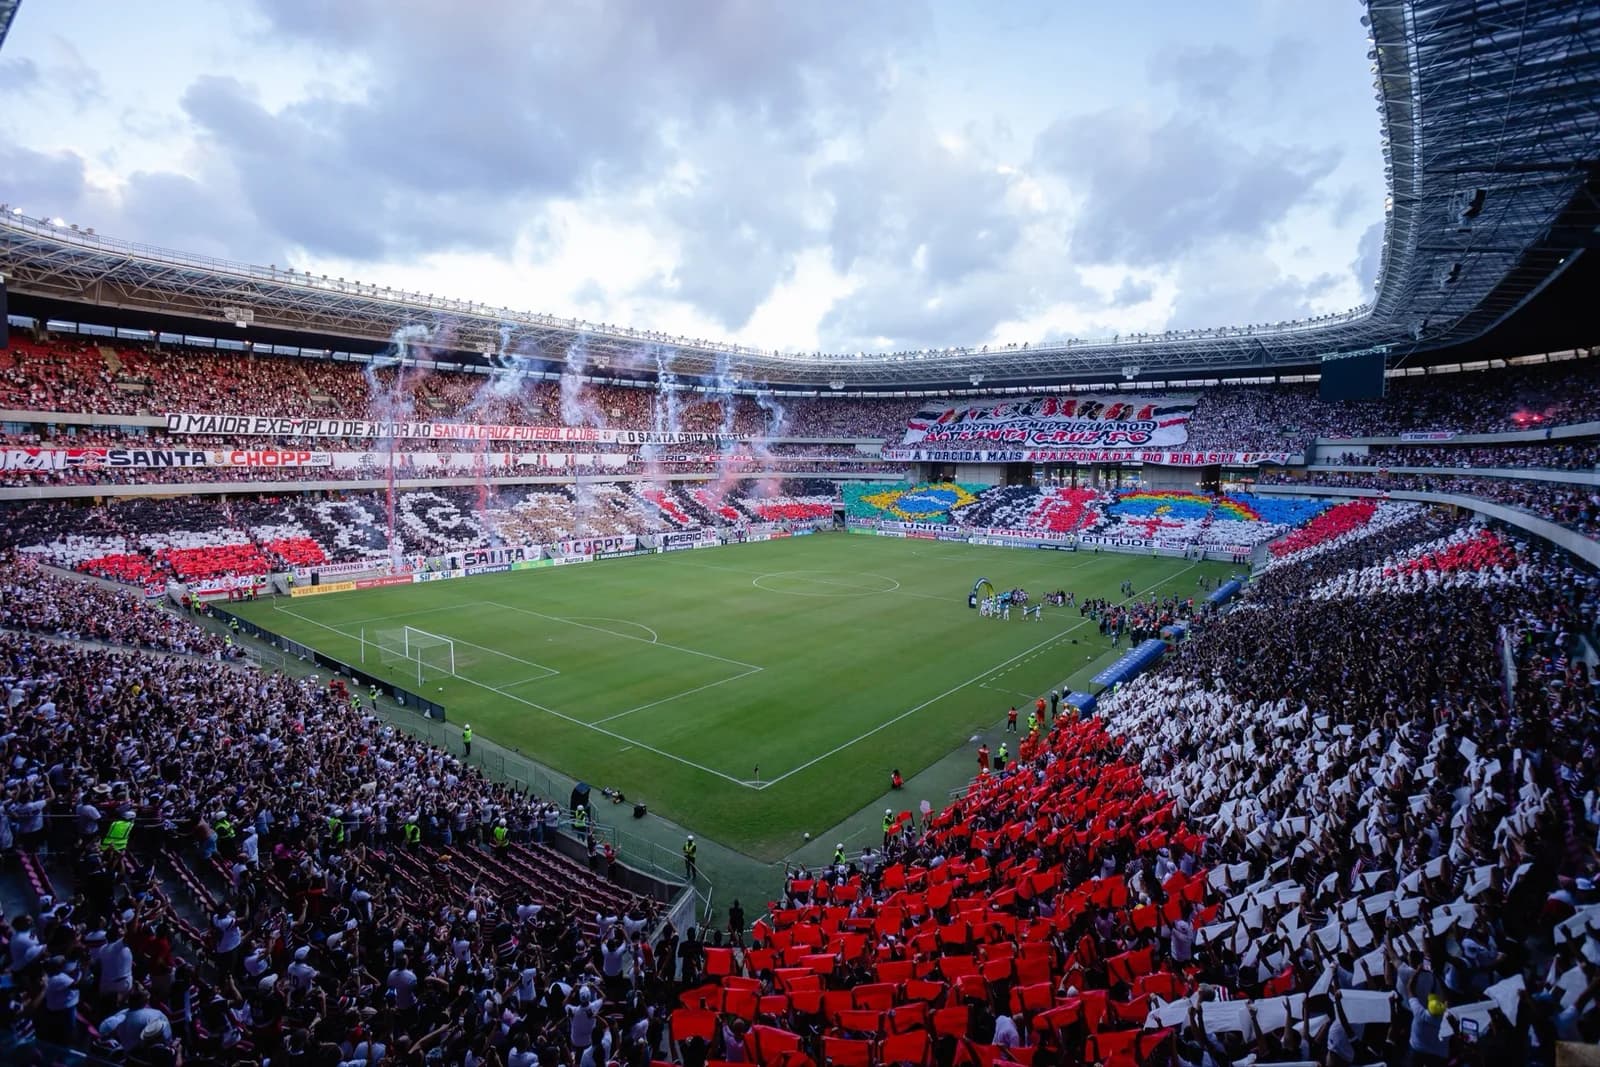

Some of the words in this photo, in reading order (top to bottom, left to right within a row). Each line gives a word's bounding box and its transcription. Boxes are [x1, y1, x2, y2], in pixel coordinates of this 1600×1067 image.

[168, 414, 181, 432] O
[184, 415, 250, 433] MAIOR
[253, 418, 339, 436] EXEMPLO
[342, 420, 364, 436] DE
[367, 421, 409, 437] AMOR
[412, 424, 431, 437] AO
[434, 424, 475, 438] SANTA
[478, 425, 511, 439] CRUZ
[513, 426, 563, 440] FUTEBOL
[566, 429, 600, 441] CLUBE
[1101, 421, 1154, 432] AMOR
[628, 432, 636, 443] O
[638, 432, 675, 443] SANTA
[678, 433, 703, 442] CRUZ
[1034, 431, 1101, 442] CRUZ
[1107, 431, 1150, 442] FC
[109, 450, 207, 466] SANTA
[230, 450, 311, 466] CHOPP
[913, 450, 923, 461] A
[926, 451, 981, 461] TORCIDA
[987, 451, 1024, 461] MAIS
[1028, 451, 1133, 461] APAIXONADA
[1142, 451, 1162, 462] DO
[1081, 535, 1155, 547] ATITUDE
